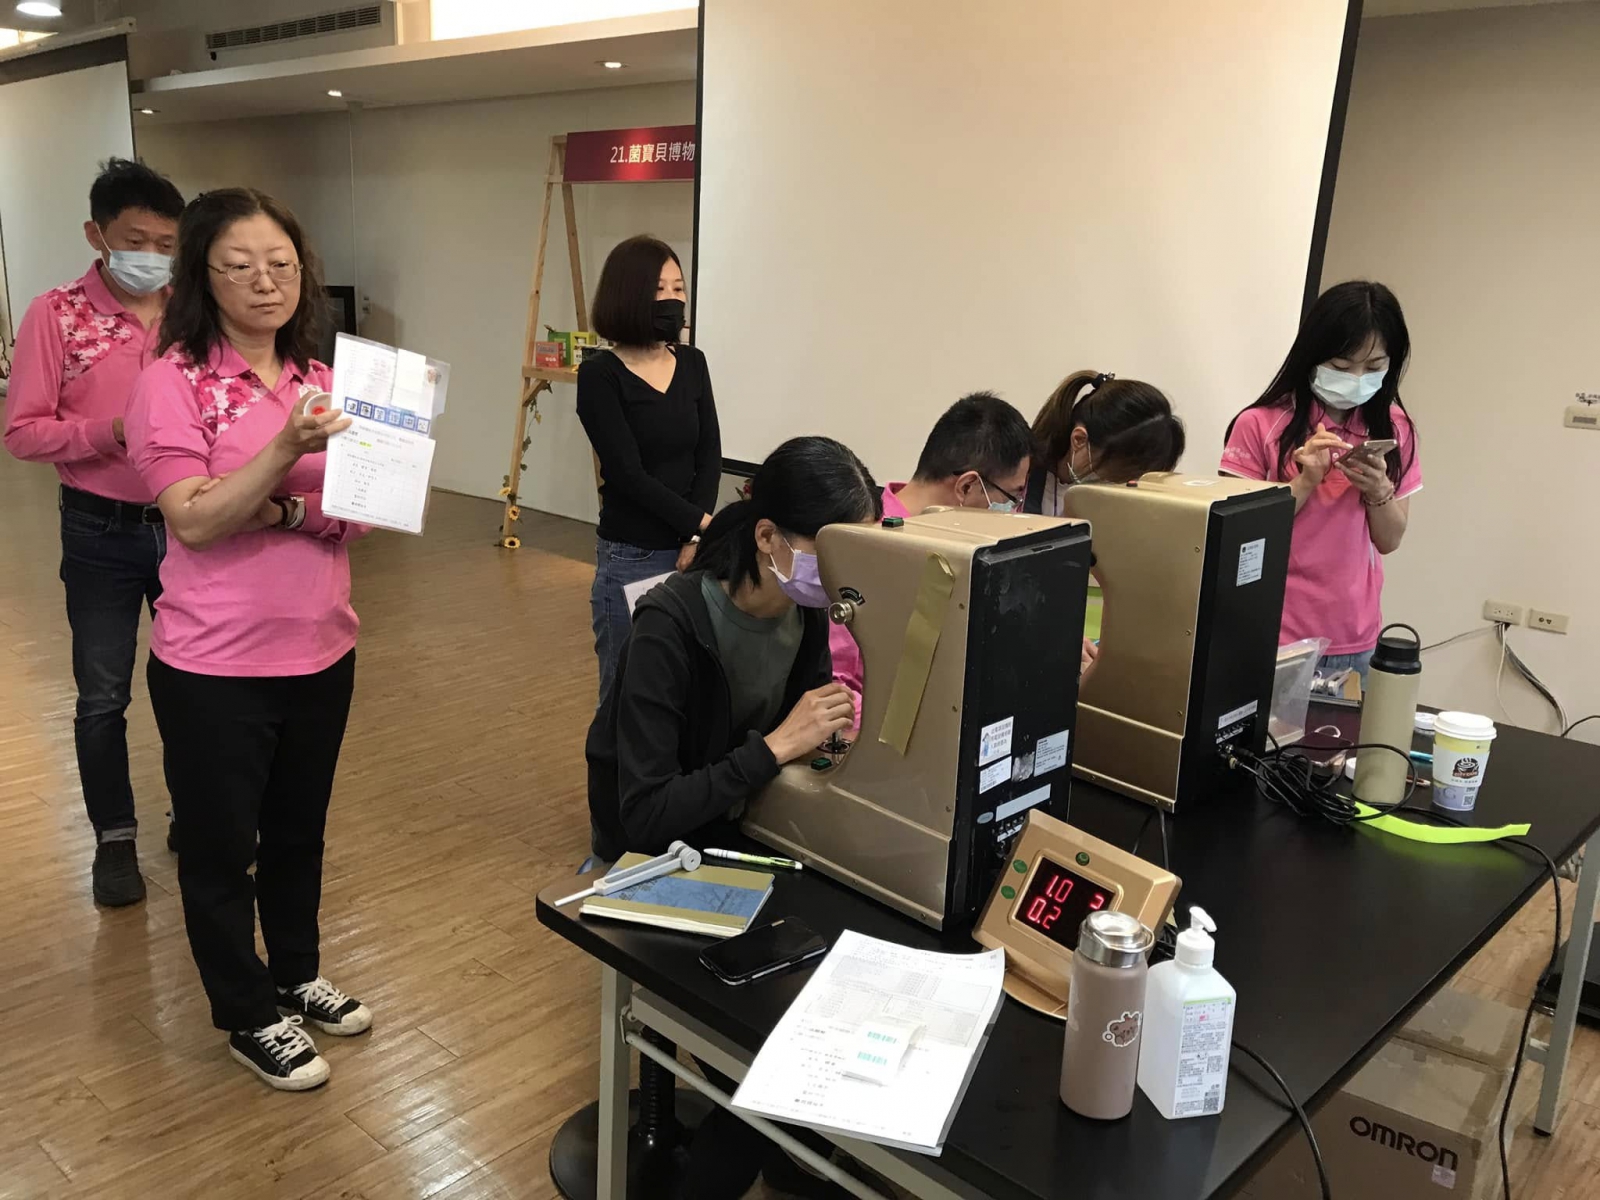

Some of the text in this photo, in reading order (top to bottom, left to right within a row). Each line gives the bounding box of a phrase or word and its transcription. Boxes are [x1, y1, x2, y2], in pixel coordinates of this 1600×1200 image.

[610, 141, 695, 164] 21.菌寶貝博物
[1045, 874, 1074, 904] 1.0
[1027, 896, 1062, 930] 0.2
[1349, 1115, 1459, 1172] OMRON
